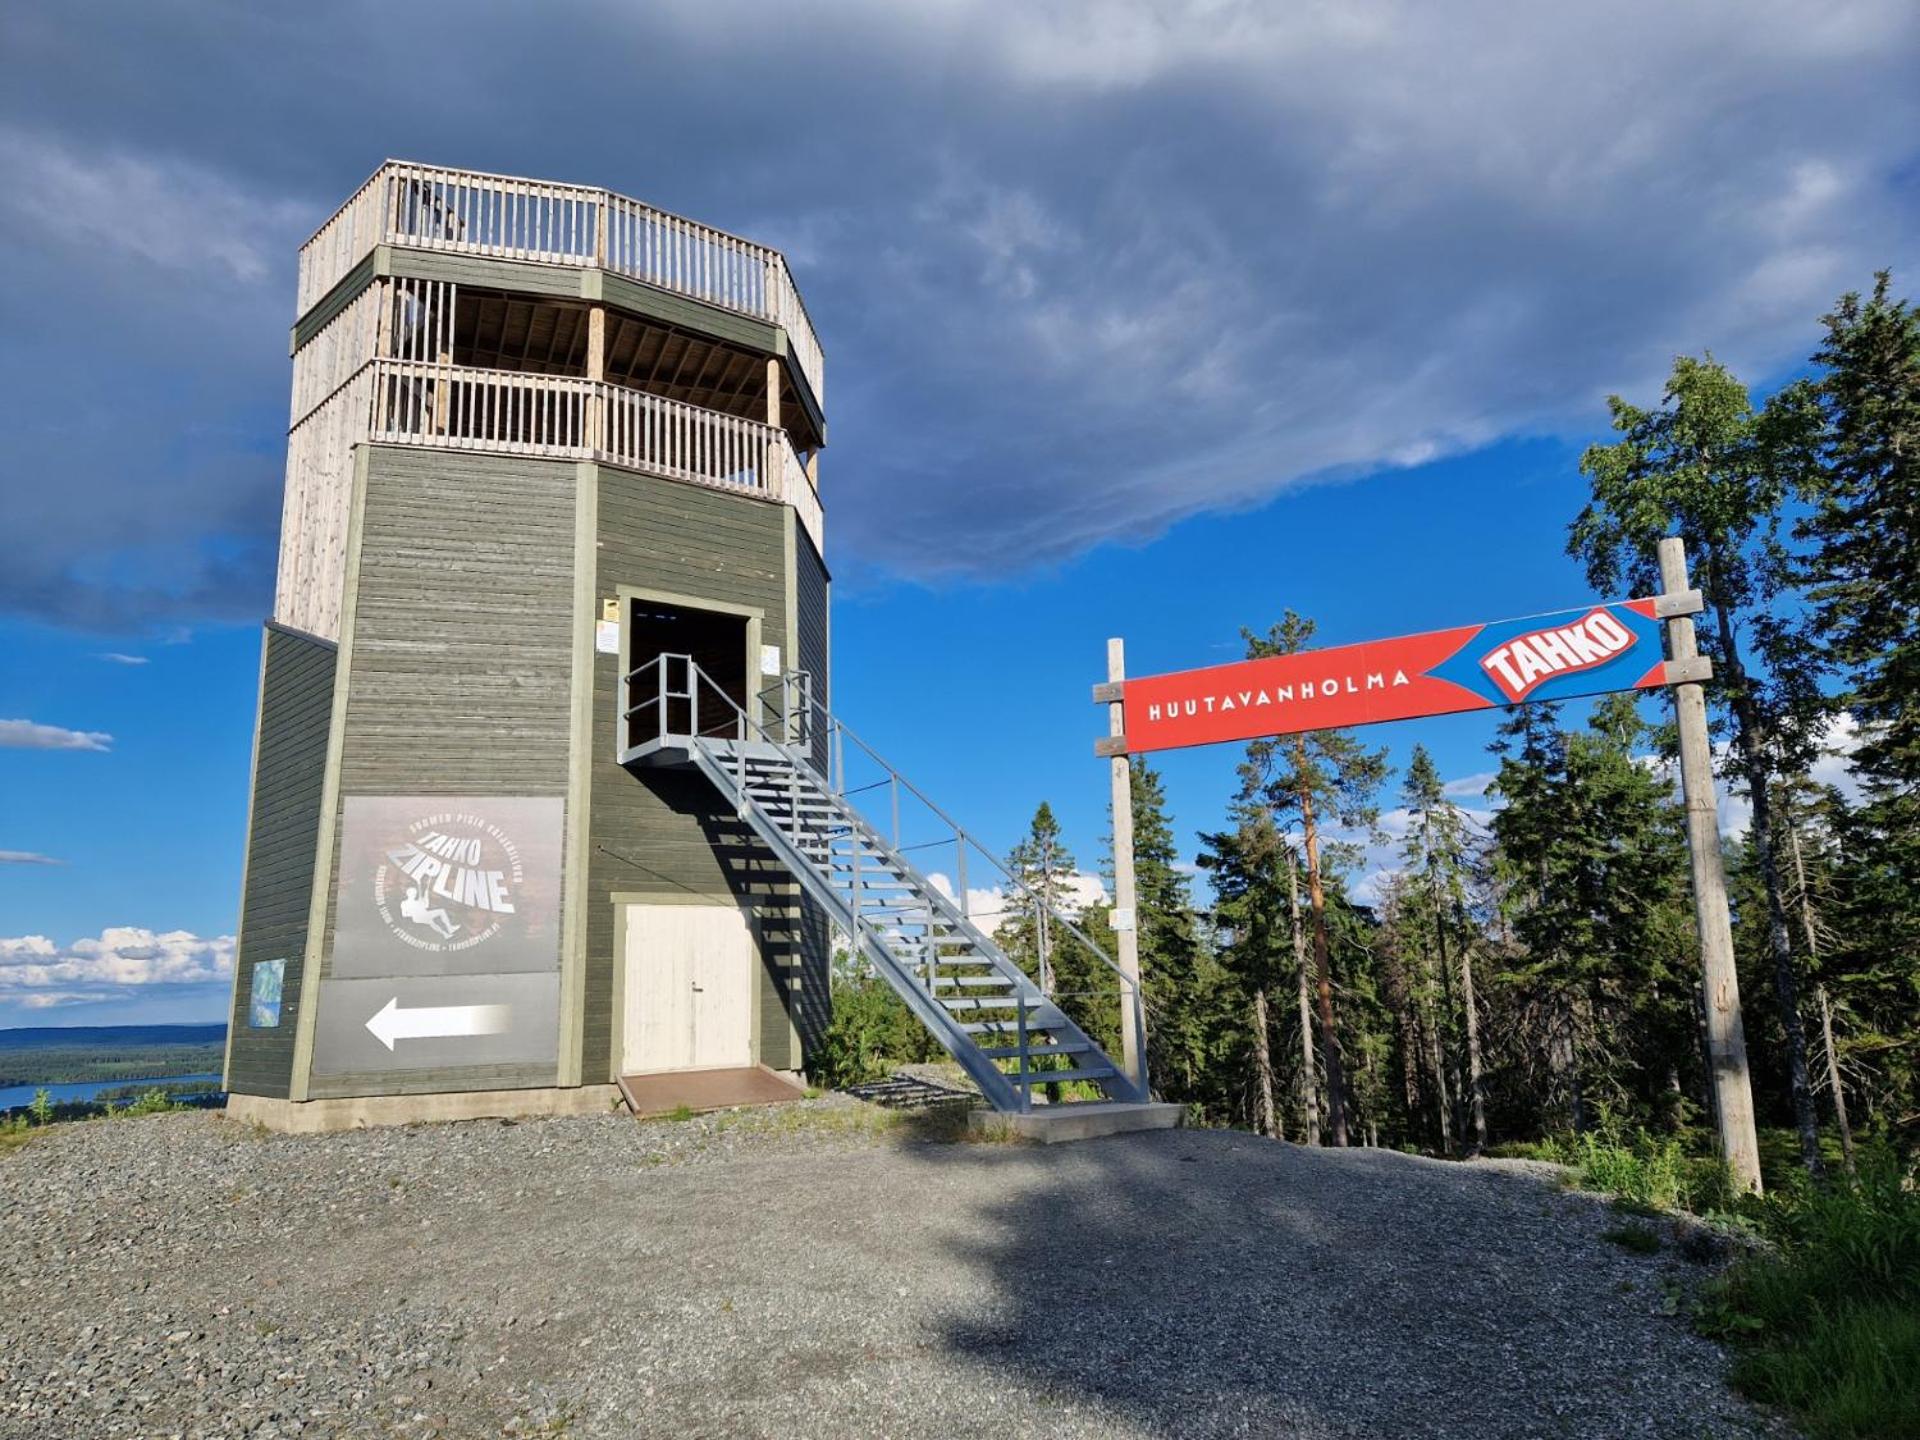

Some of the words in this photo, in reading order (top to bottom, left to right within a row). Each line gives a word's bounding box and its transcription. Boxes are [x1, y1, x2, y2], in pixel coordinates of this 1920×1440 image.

[1483, 612, 1630, 693] TAHKO
[1149, 669, 1409, 721] HUUTAVANHOLMA
[386, 842, 516, 914] ZIPLINE
[416, 831, 481, 867] TAHKO
